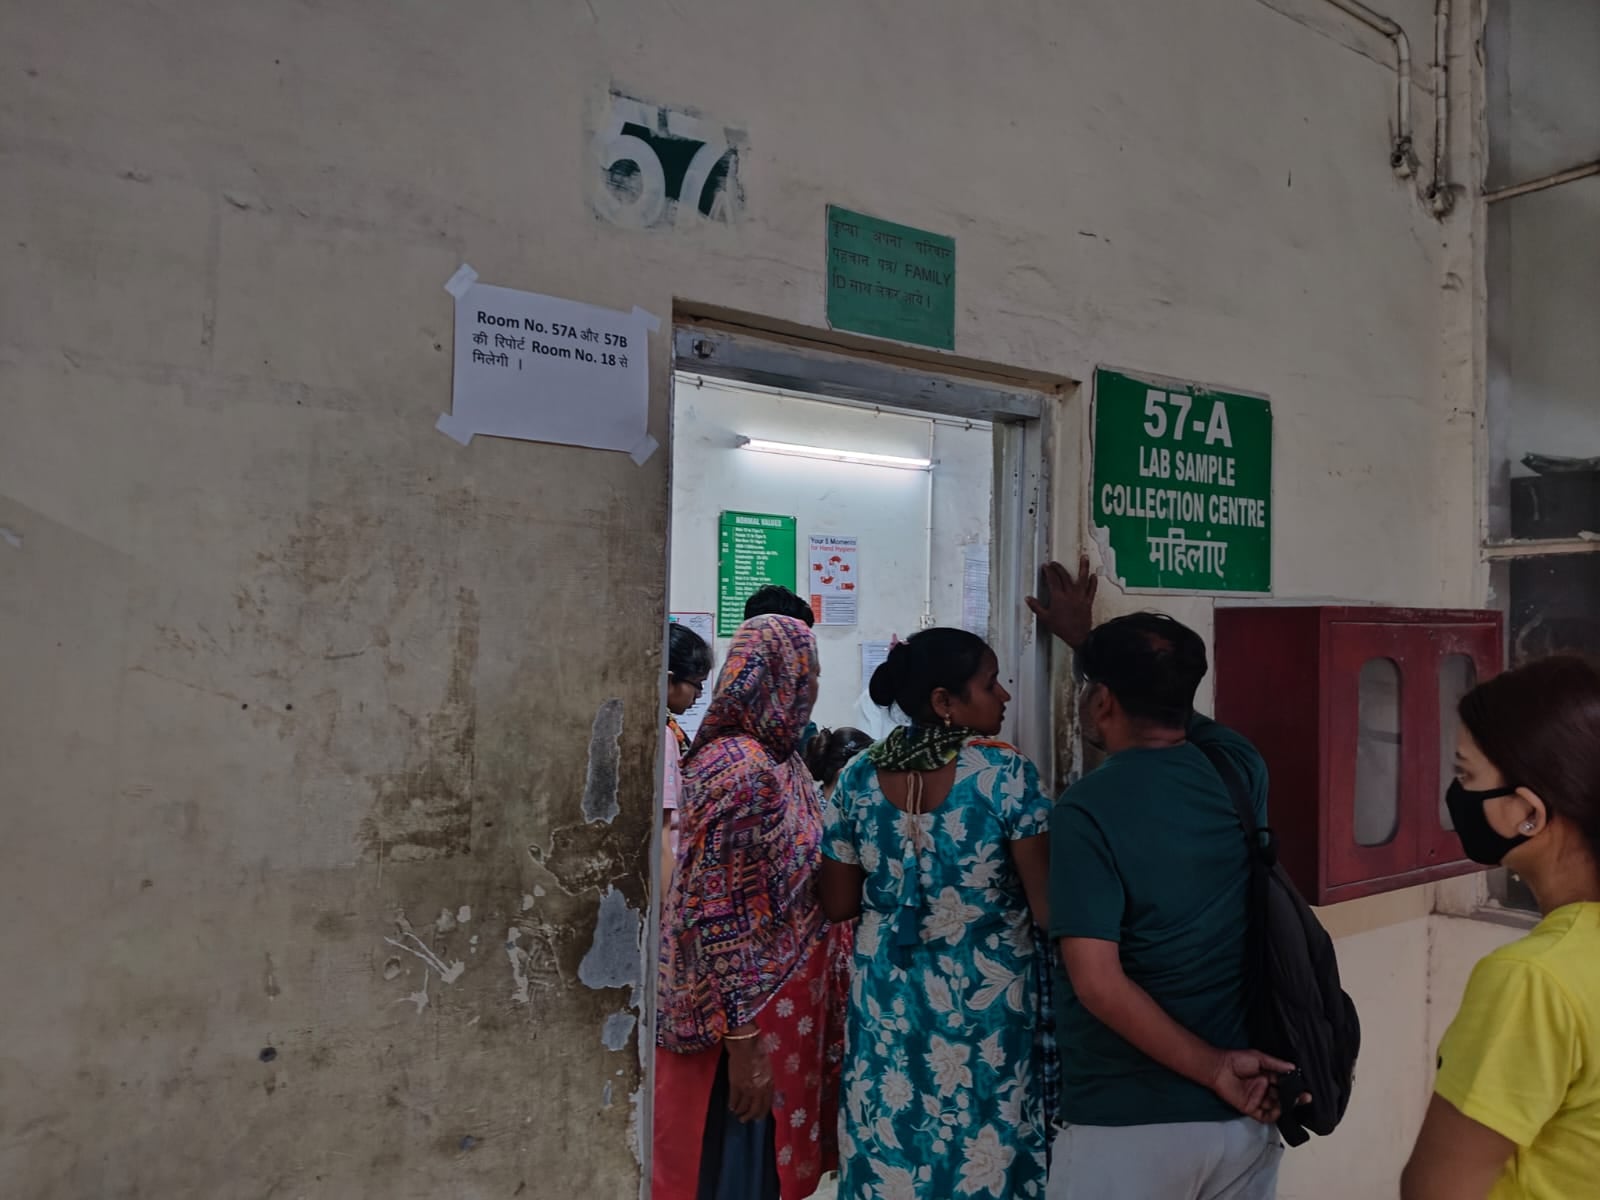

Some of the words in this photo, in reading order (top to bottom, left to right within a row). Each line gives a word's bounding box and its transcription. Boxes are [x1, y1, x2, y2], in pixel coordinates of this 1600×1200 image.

[904, 263, 952, 289] FAMILY
[477, 311, 520, 329] Room
[524, 318, 548, 335] No.
[552, 323, 578, 340] 57A
[580, 328, 600, 344] और
[604, 333, 628, 348] 57B
[472, 332, 488, 347] की
[495, 334, 526, 351] रिपोर्ट
[532, 341, 571, 359] Room
[575, 348, 597, 364] No.
[600, 352, 616, 366] 18
[619, 354, 629, 369] से
[472, 348, 509, 368] मिलेगी
[1143, 388, 1233, 448] 57-A
[1139, 445, 1171, 479] LAB
[1175, 450, 1236, 487] SAMPLE
[1101, 483, 1204, 523] COLLECTION
[1208, 494, 1265, 528] CENTRE
